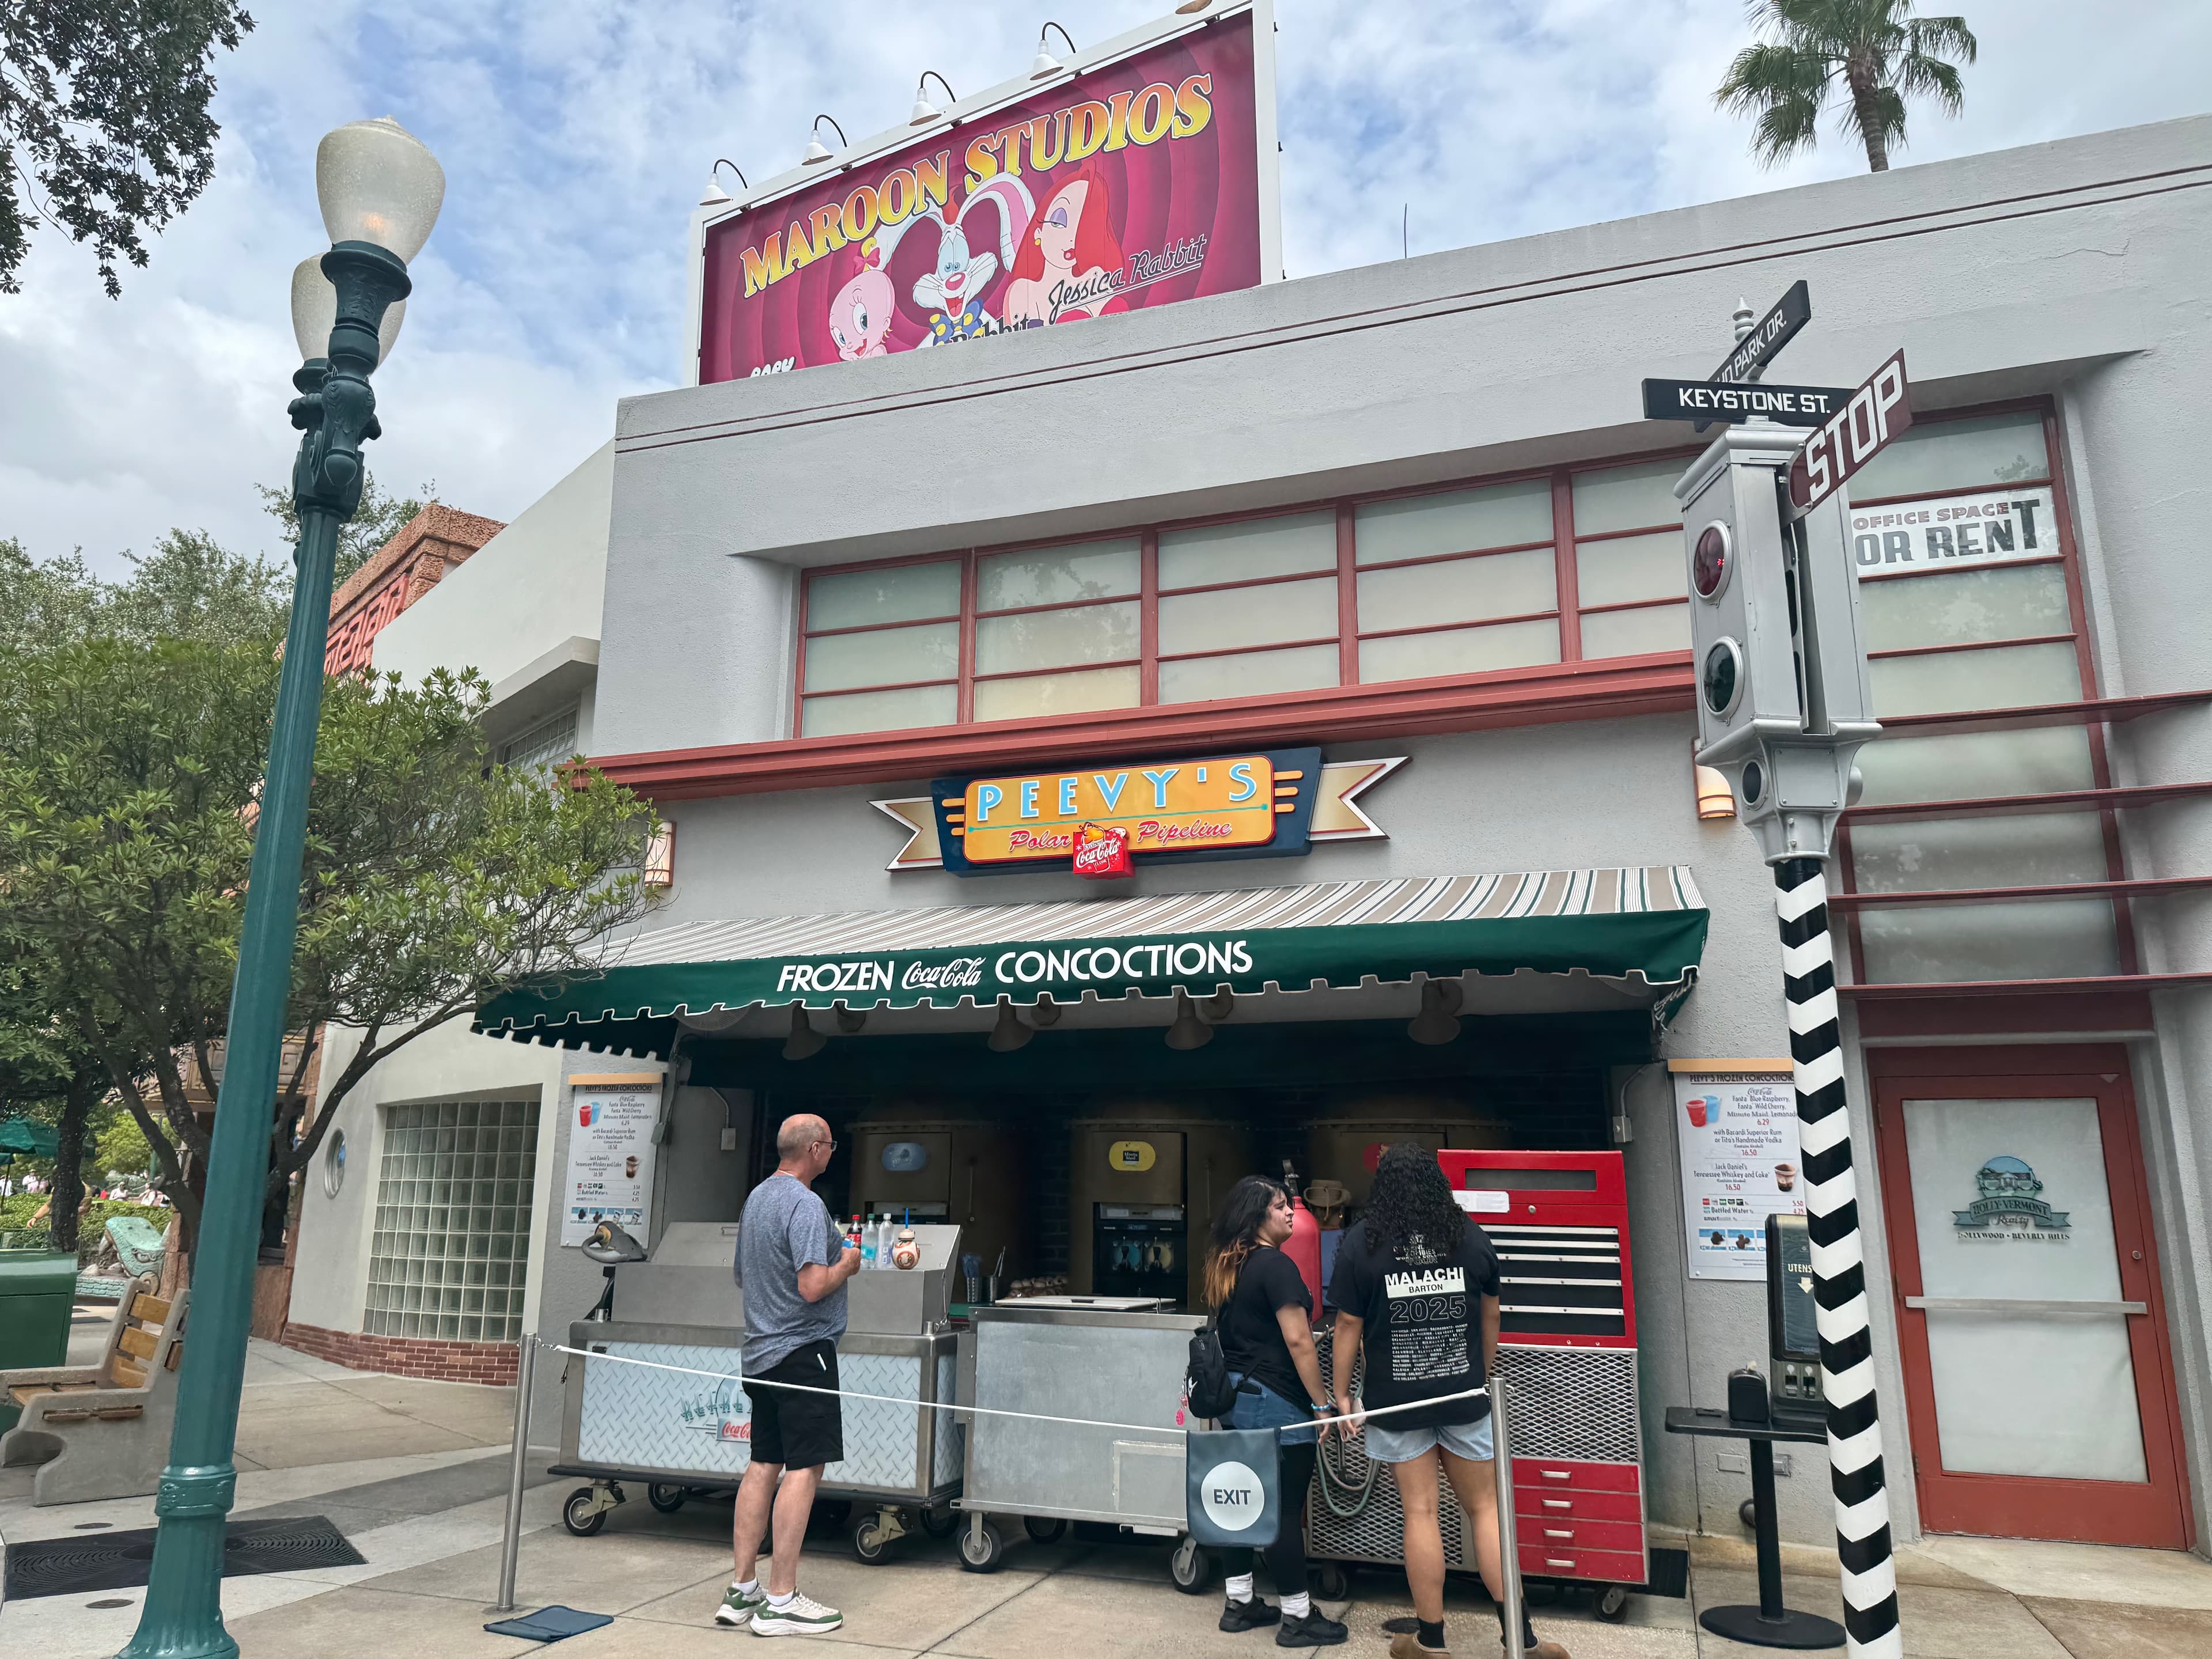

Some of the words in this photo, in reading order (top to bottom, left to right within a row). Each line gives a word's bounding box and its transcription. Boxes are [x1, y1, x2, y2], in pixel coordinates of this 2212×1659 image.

[740, 149, 950, 299] MAROON
[964, 72, 1213, 195] STUDIOS
[1048, 269, 1126, 319] Jessica
[1128, 233, 1207, 287] Rabbit
[1734, 329, 1765, 377] PARK
[1767, 309, 1787, 342] DR.
[1679, 388, 1796, 412] KEYSTONE
[1801, 393, 1831, 414] ST.
[1805, 359, 1903, 503] STOP
[1853, 510, 1930, 531] OFFICE
[1937, 502, 2009, 521] SPACE
[1855, 531, 1914, 565] OR
[1926, 499, 2040, 559] RENT
[977, 762, 1258, 822] PEEVY'S
[1008, 830, 1072, 851] Polar
[1137, 820, 1232, 847] Pipeline
[1076, 838, 1119, 868] Coca-Cola
[776, 960, 895, 992] FROZEN
[902, 956, 987, 990] Coca-Cola
[995, 940, 1253, 983] CONCOCTIONS
[1384, 1267, 1464, 1286] MALACHI
[1788, 1263, 1813, 1273] UTENS
[1409, 1284, 1443, 1294] BARTON
[1390, 1296, 1466, 1323] 2025
[722, 1421, 751, 1438] Coca-C
[1213, 1489, 1251, 1505] EXIT
